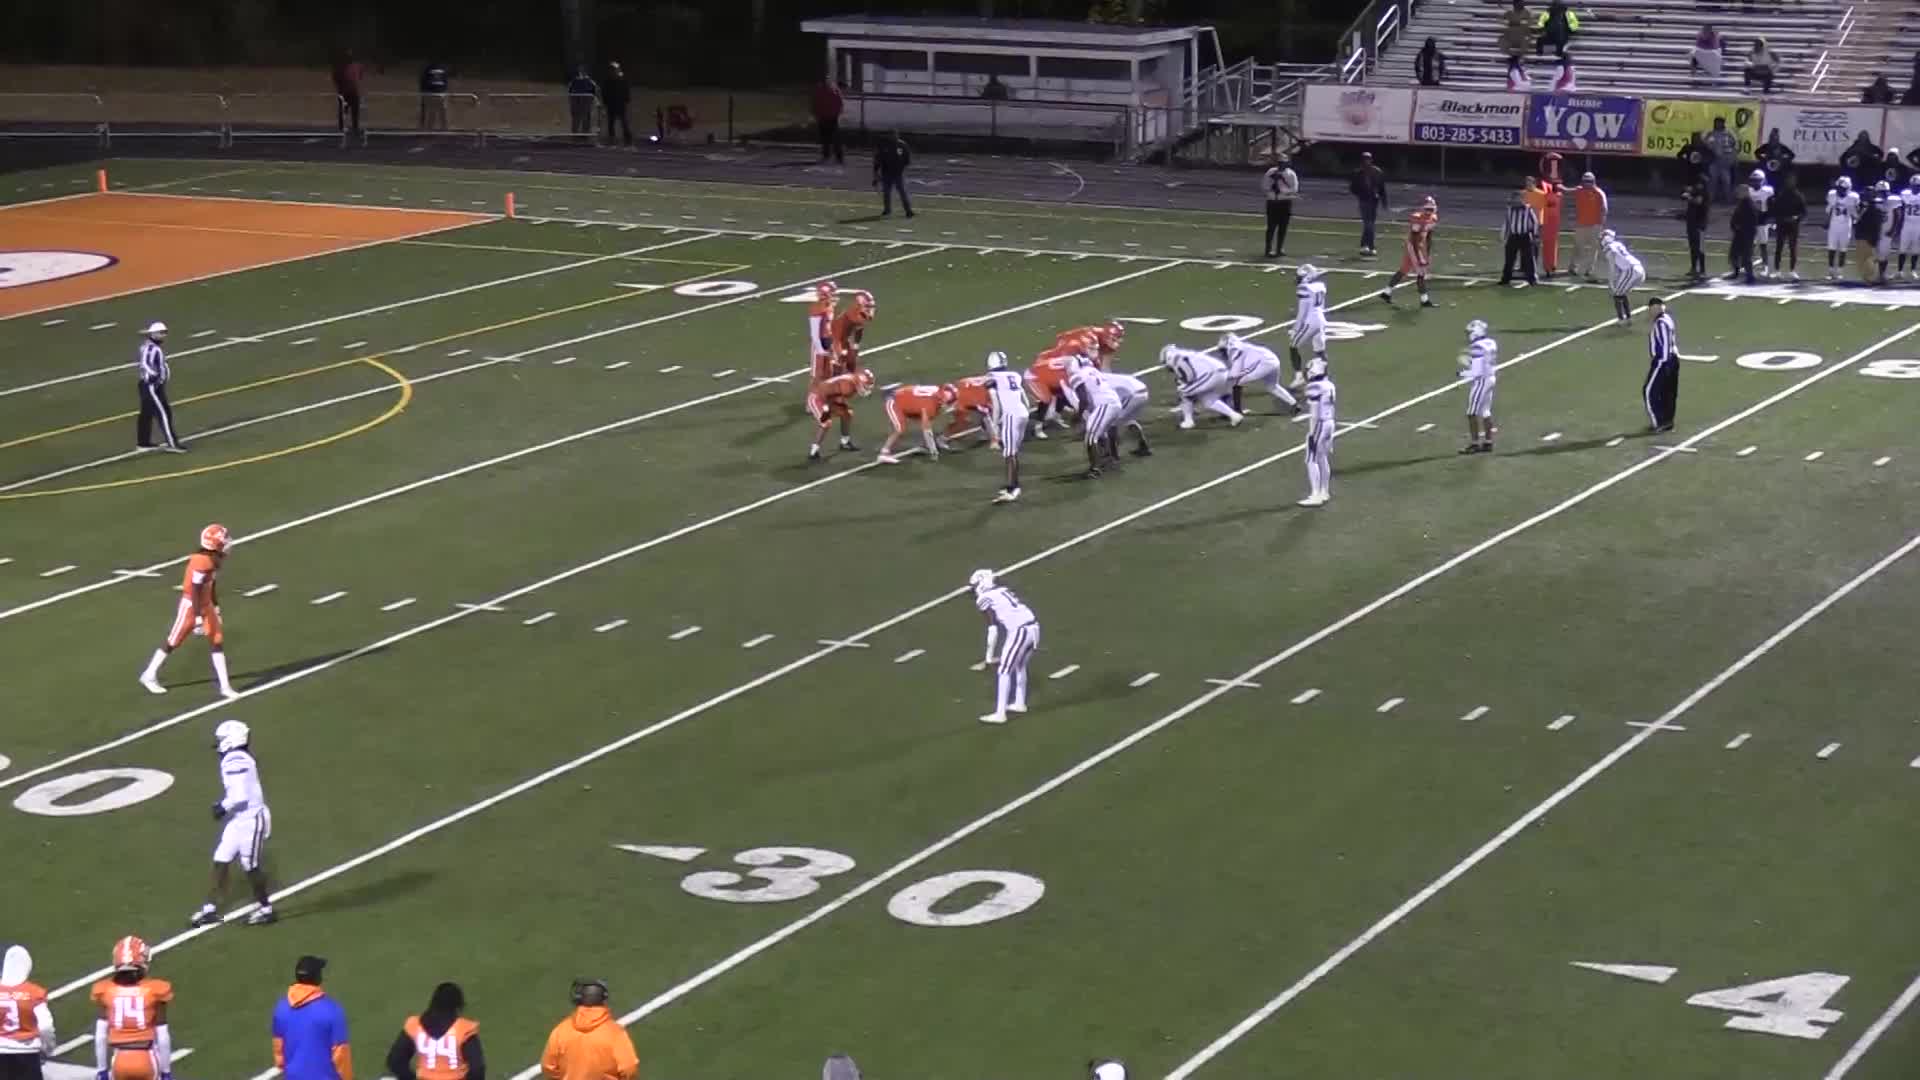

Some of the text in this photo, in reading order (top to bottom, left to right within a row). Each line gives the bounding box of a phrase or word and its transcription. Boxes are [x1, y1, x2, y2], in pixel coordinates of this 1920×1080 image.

[1421, 125, 1513, 144] 803-285-5433
[1543, 105, 1625, 139] YOW
[112, 996, 147, 1031] 14
[417, 1031, 458, 1070] 44
